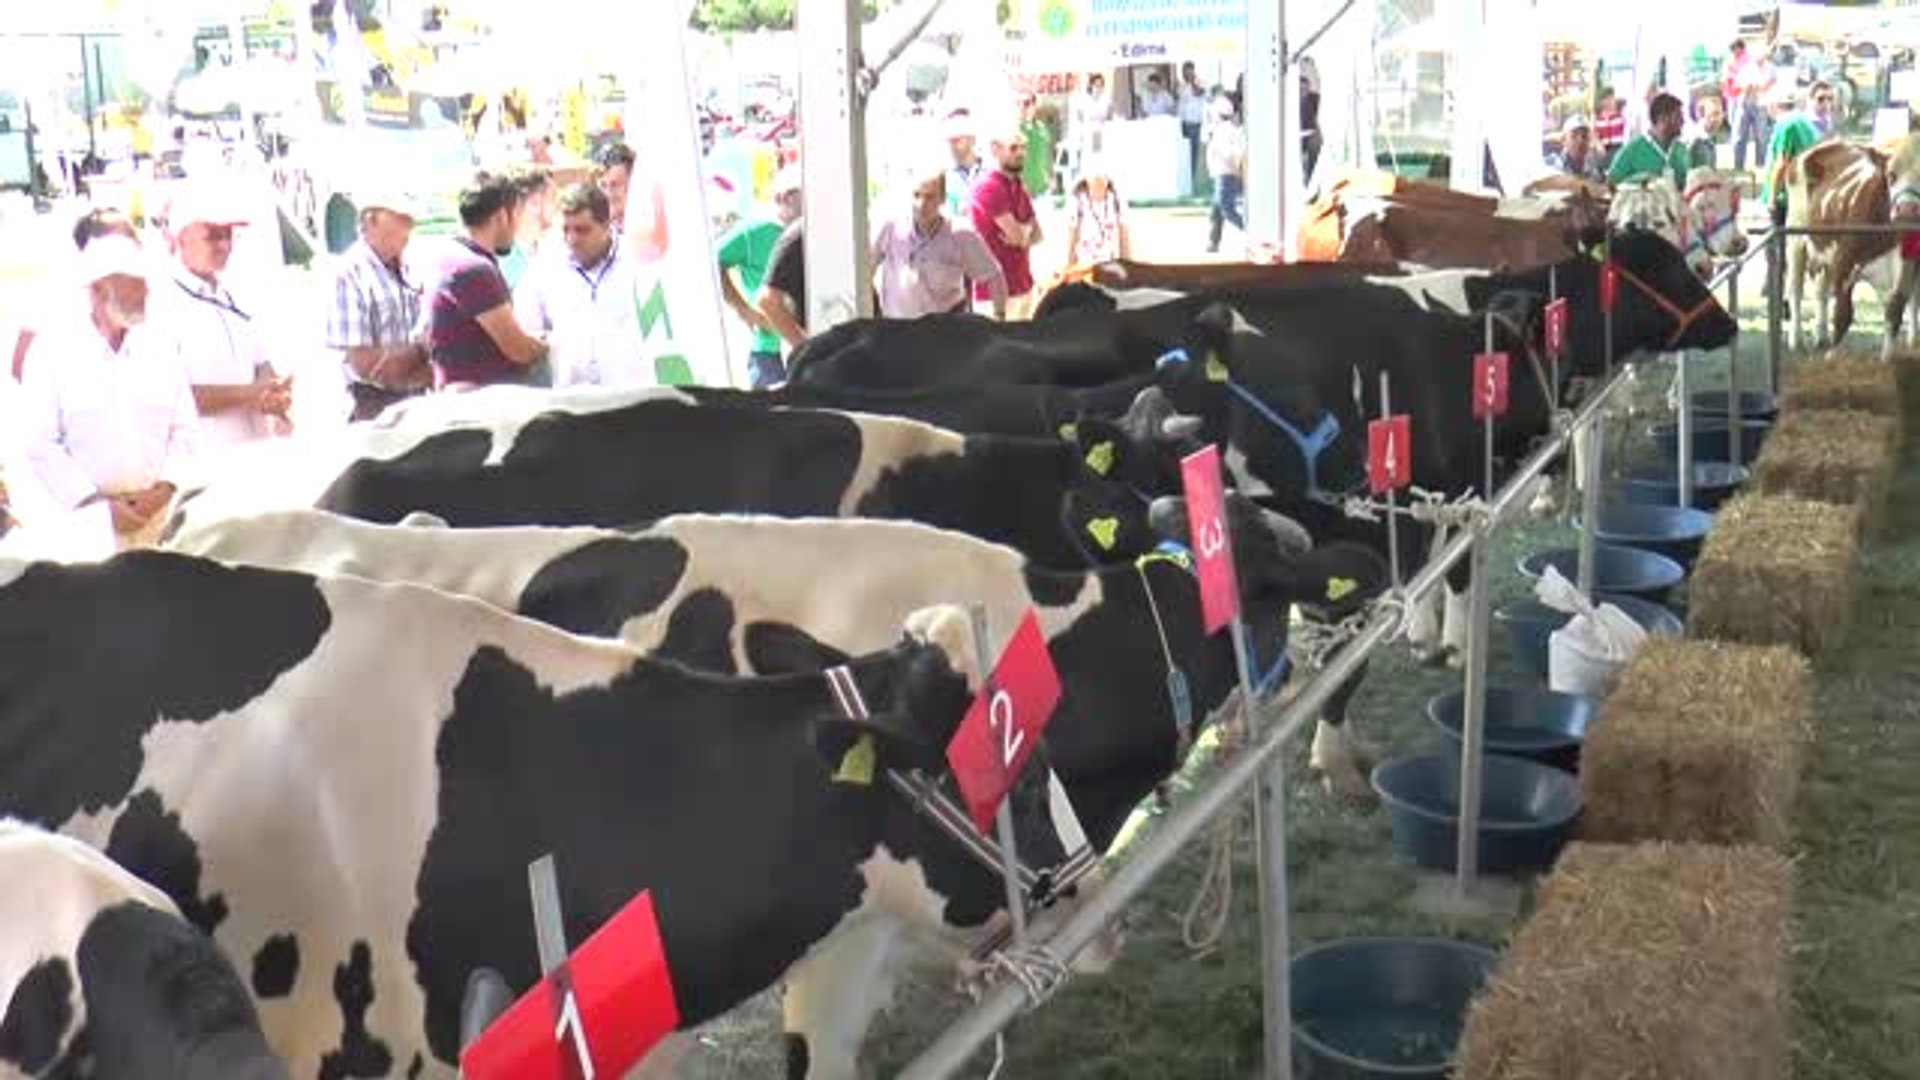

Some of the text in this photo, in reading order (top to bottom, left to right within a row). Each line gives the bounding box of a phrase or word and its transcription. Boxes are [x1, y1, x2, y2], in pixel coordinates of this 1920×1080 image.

[1484, 364, 1496, 406] 5
[1384, 430, 1397, 480] 4
[1200, 517, 1224, 559] 3
[990, 690, 1024, 768] 2
[555, 990, 595, 1080] 1
